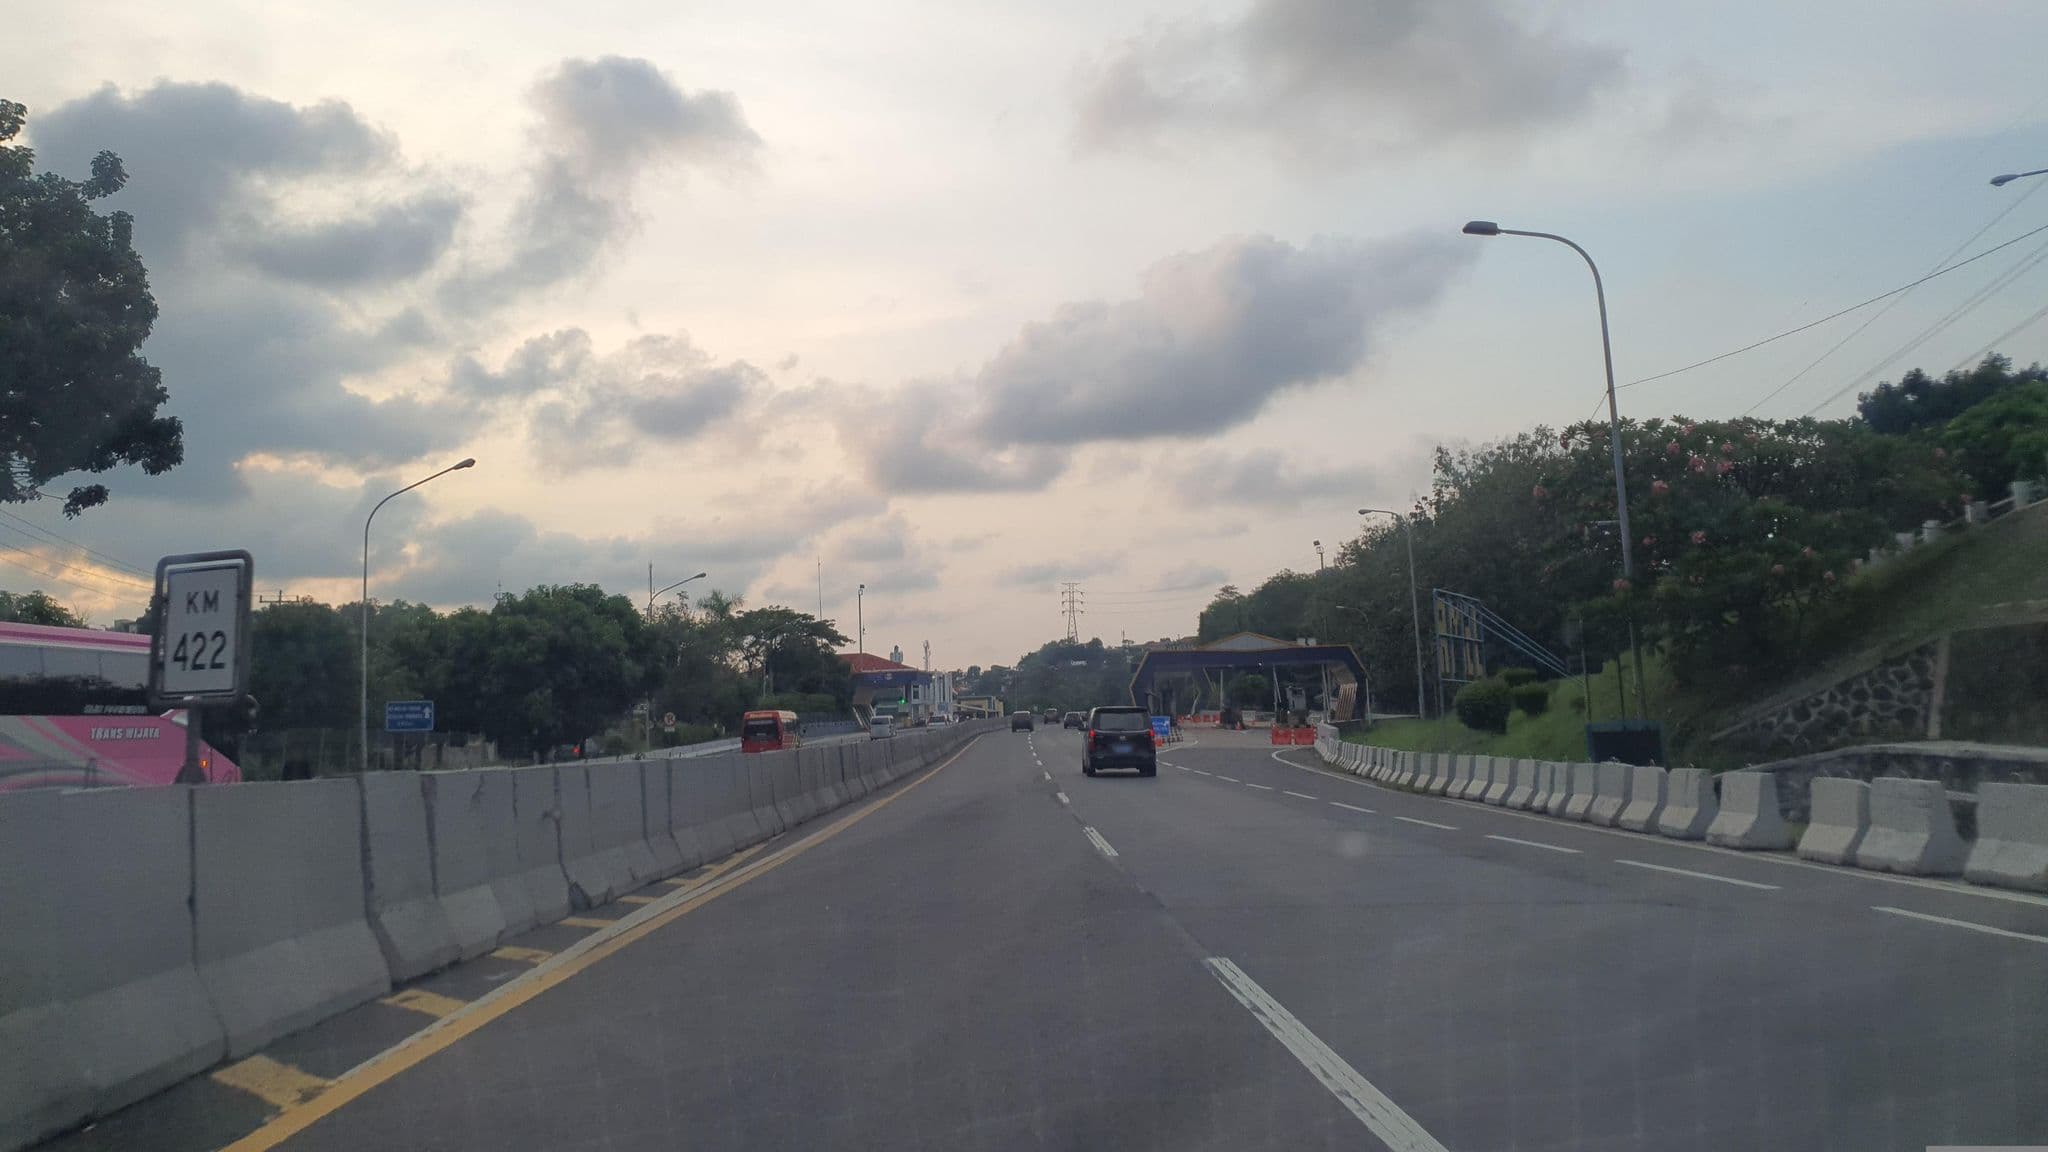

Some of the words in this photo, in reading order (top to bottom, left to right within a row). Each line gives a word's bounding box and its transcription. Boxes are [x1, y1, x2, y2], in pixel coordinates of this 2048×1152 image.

[186, 590, 219, 614] KM
[173, 630, 226, 671] 422
[91, 727, 123, 740] TRANS
[125, 727, 160, 739] WIJAYA
